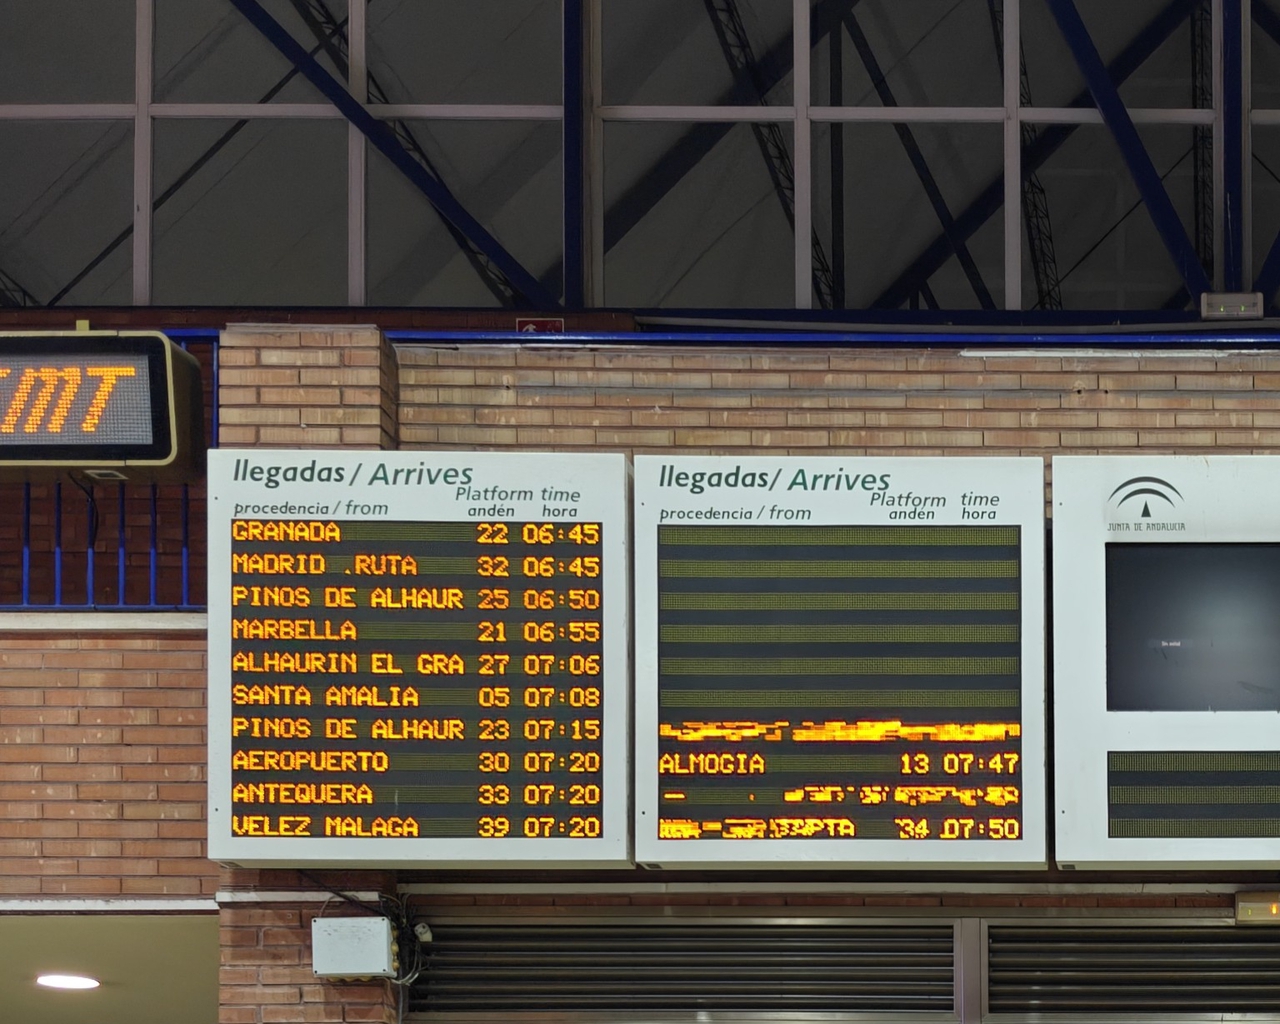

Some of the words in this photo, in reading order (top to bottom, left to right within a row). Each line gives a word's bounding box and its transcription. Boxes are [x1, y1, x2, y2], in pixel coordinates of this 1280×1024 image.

[0, 366, 136, 433] MT
[368, 462, 473, 487] Arrives
[787, 468, 891, 491] Arrives
[455, 486, 533, 503] Platform
[541, 487, 581, 503] time
[344, 500, 388, 515] from
[467, 504, 514, 517] andén
[542, 505, 578, 518] hora
[232, 521, 341, 542] GRANADA
[476, 523, 509, 544] 22
[522, 523, 600, 545] 06:45
[1107, 522, 1130, 532] JUNTA
[1134, 522, 1143, 531] DE
[232, 553, 326, 574] MADRID
[477, 555, 510, 577] 32
[522, 556, 600, 578] 06:45
[232, 618, 357, 641] MARBELLA
[477, 621, 507, 642] 21
[523, 621, 600, 643] 06:55
[659, 752, 765, 774] ALMOGIA
[901, 752, 930, 774] 13
[943, 752, 1019, 774] 07:47
